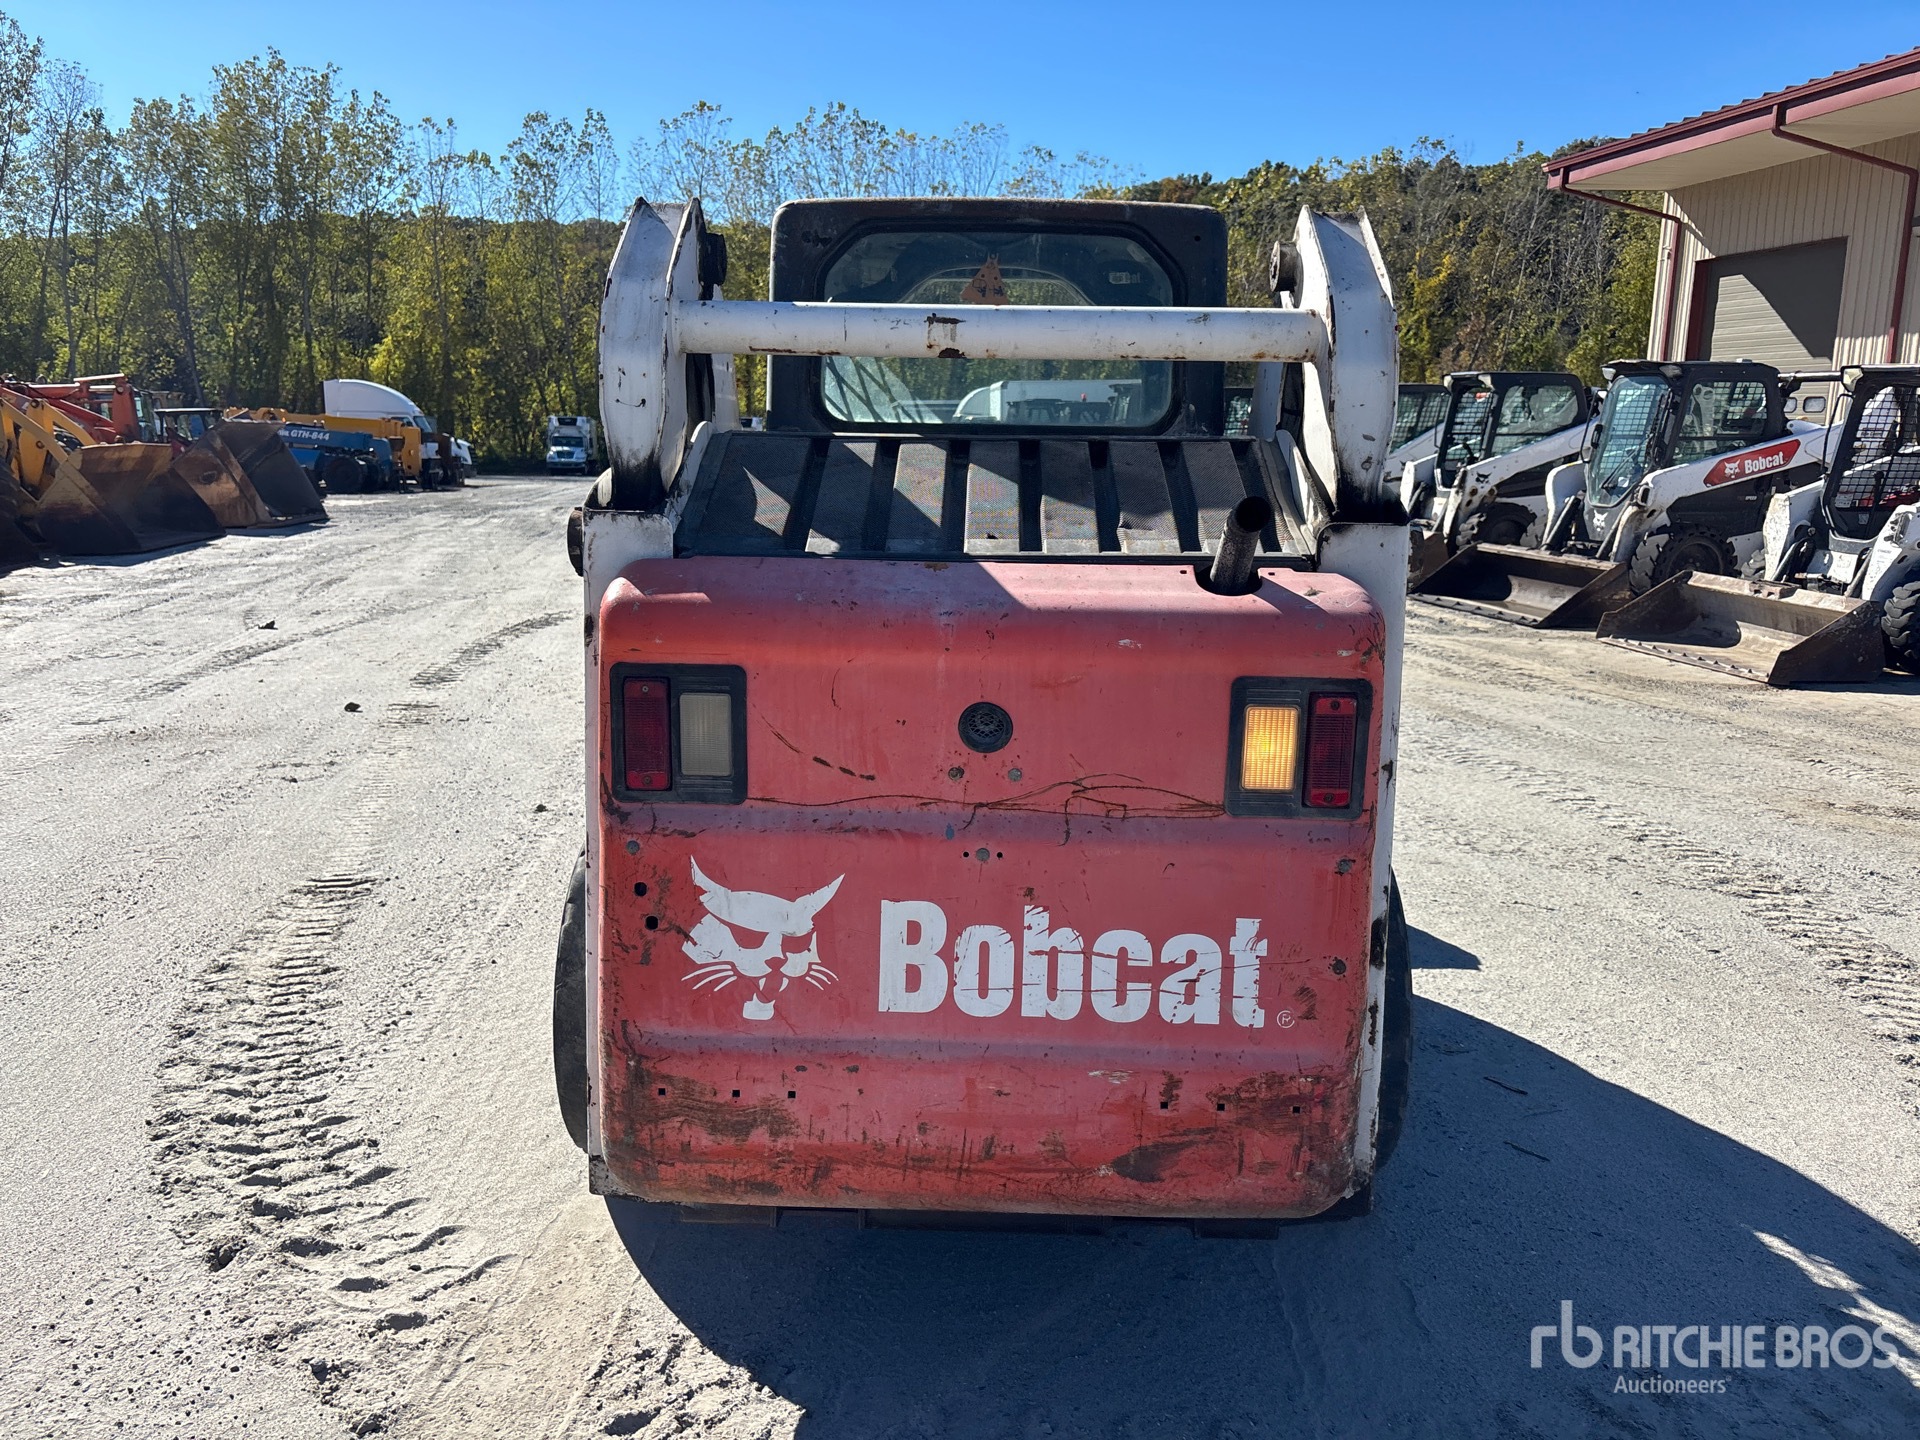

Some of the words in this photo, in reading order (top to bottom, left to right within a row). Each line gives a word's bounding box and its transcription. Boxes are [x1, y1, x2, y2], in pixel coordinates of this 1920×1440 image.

[290, 429, 330, 441] GTH-844
[1744, 451, 1784, 475] Bobcat
[878, 899, 1268, 1029] Bobcat
